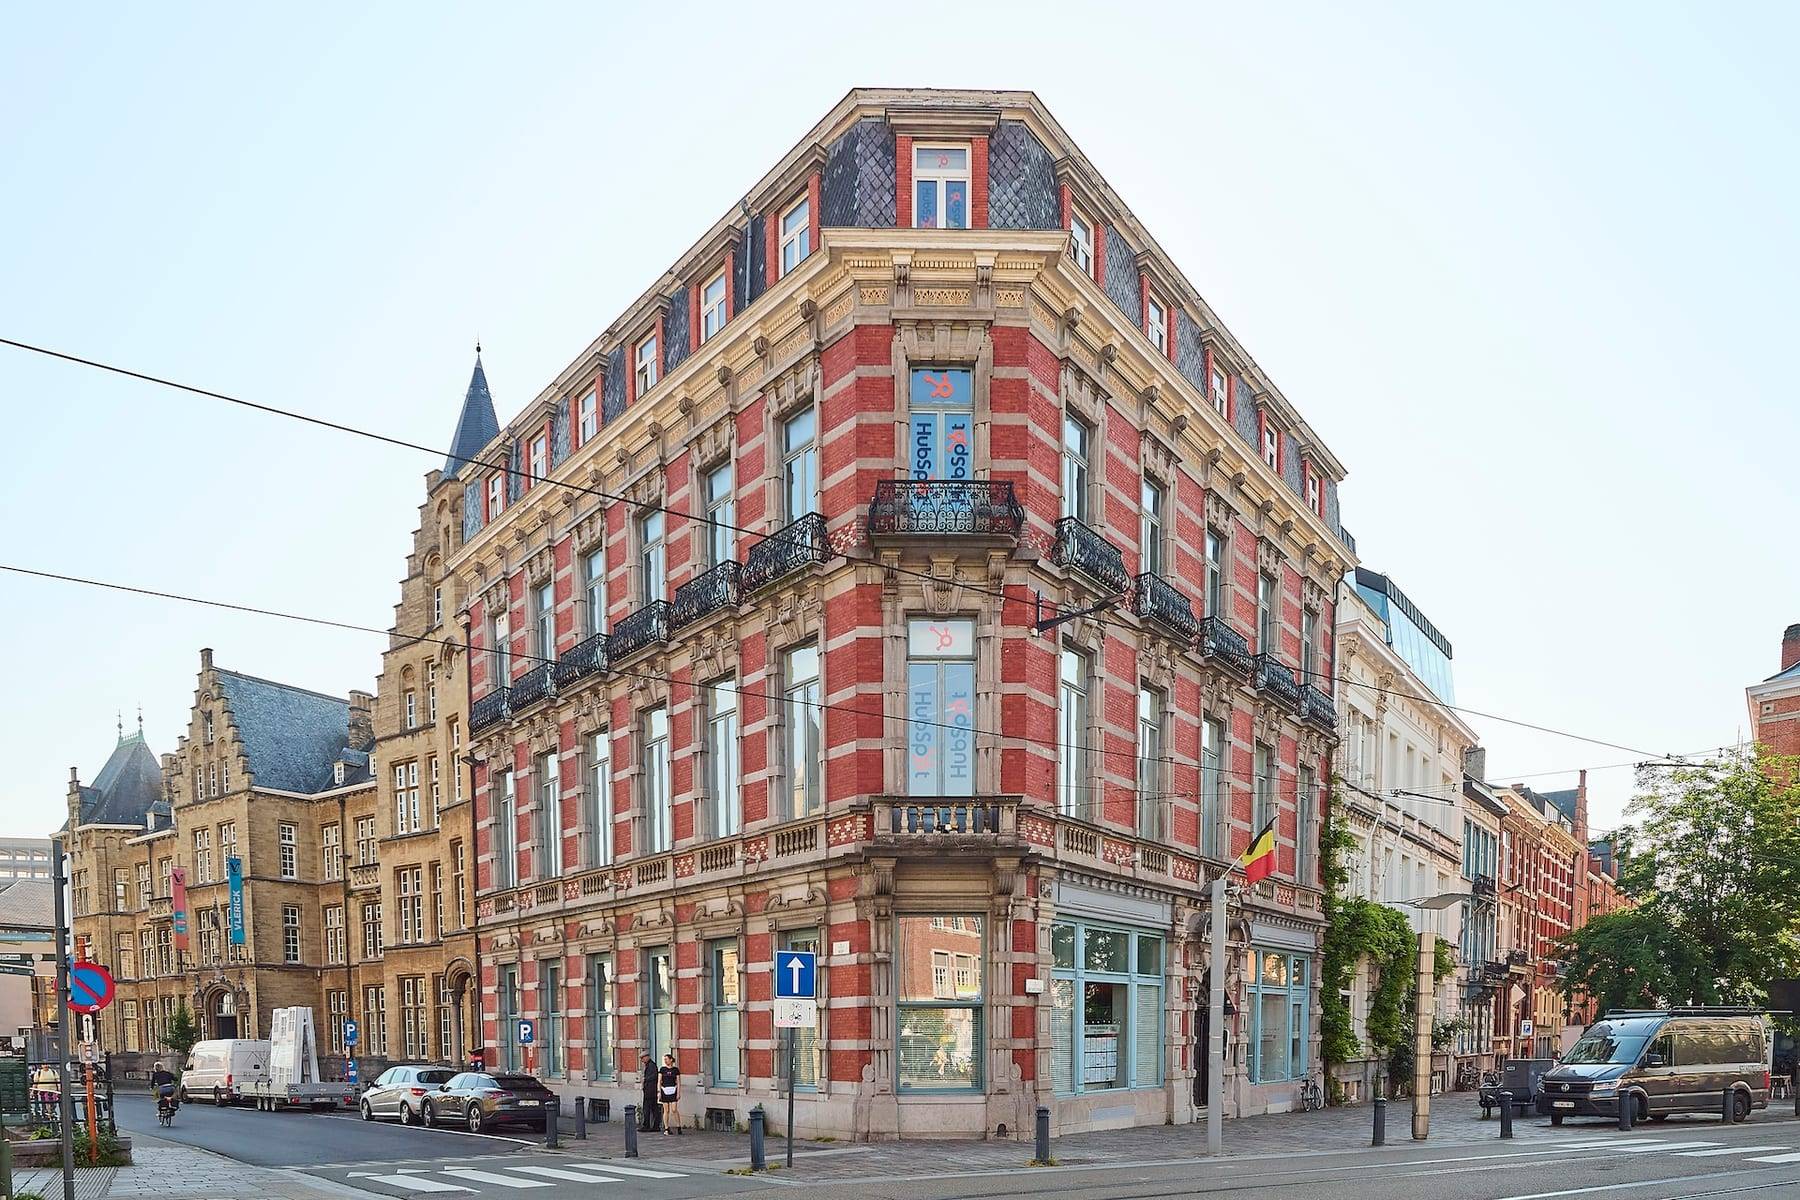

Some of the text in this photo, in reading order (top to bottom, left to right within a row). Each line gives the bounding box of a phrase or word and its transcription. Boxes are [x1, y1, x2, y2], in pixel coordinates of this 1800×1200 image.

[232, 890, 241, 931] VLERICK
[346, 1023, 356, 1037] P
[520, 1024, 532, 1040] P
